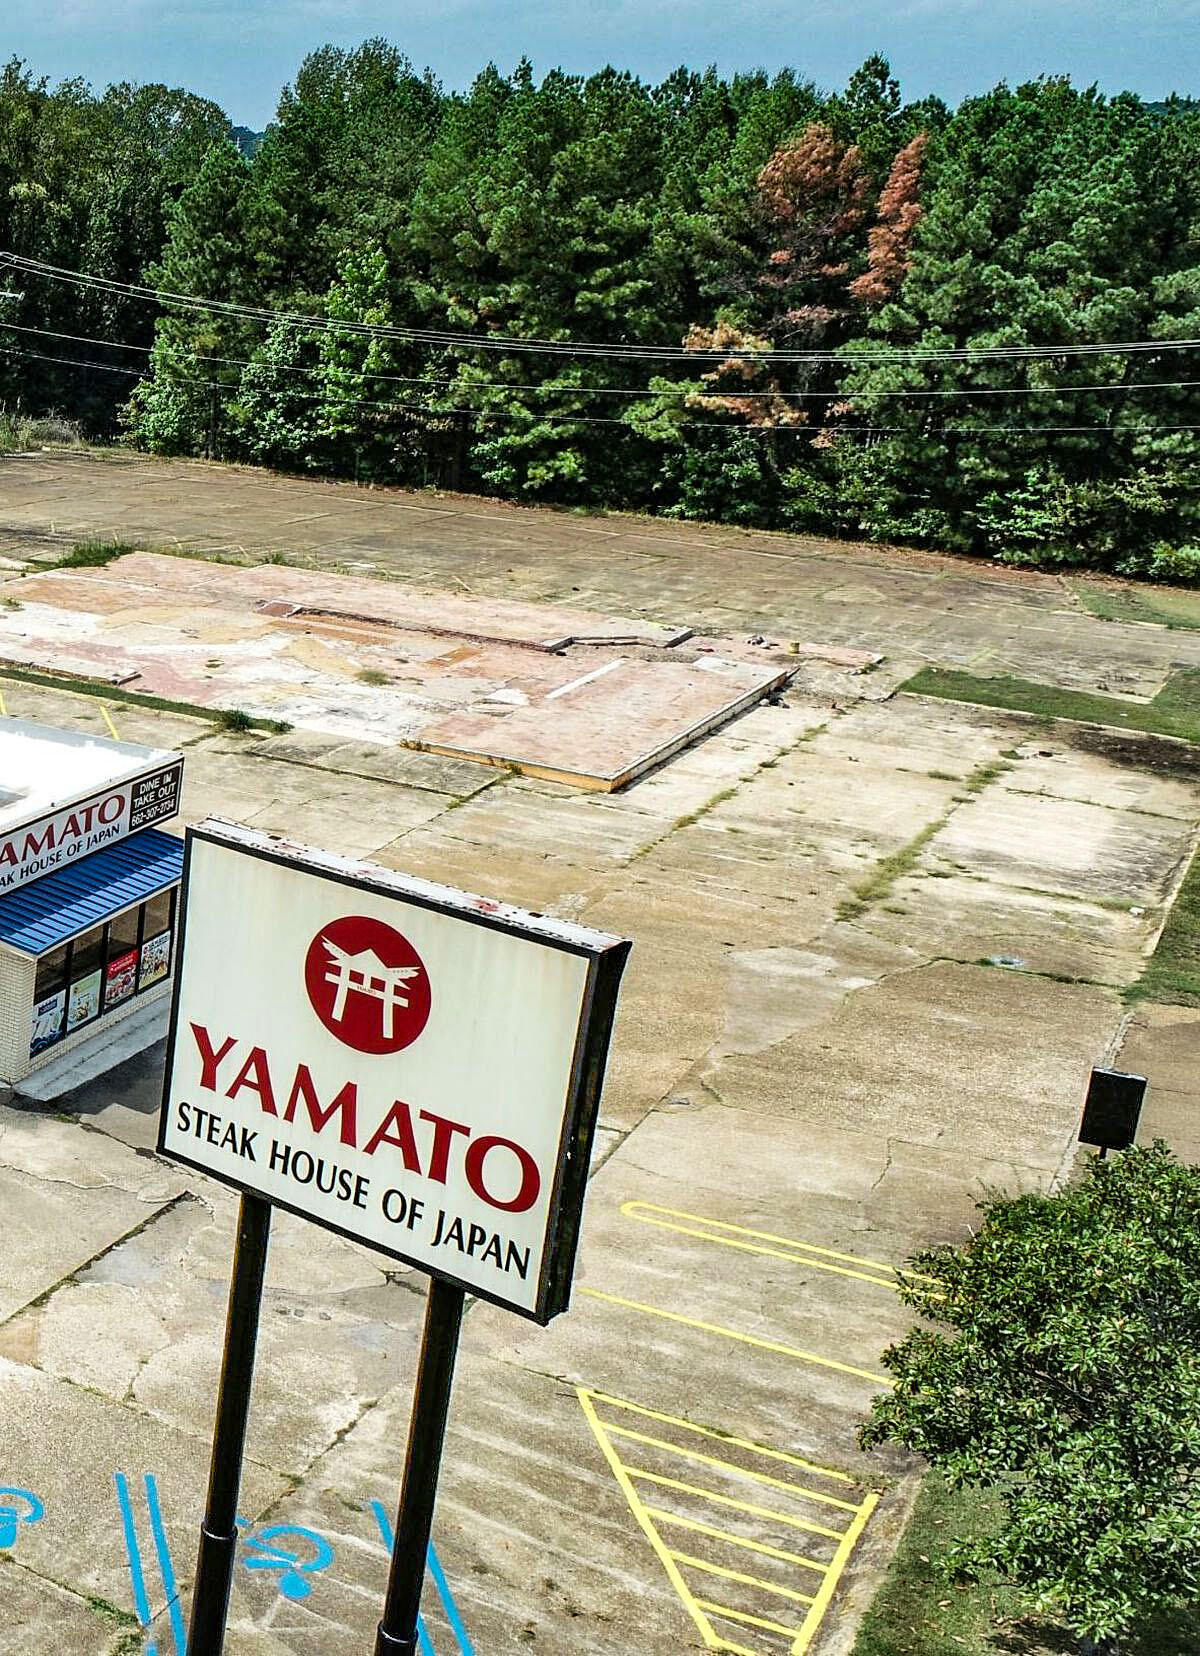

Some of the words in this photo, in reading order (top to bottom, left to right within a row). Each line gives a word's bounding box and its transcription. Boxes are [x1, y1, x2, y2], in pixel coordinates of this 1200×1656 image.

[133, 791, 155, 808] TAKE
[158, 782, 176, 798] OUT
[140, 777, 160, 795] DINE
[163, 772, 173, 785] IN
[20, 850, 62, 879] HOUSE
[66, 841, 84, 857] OF
[87, 823, 120, 850] JAPAN
[189, 1022, 541, 1214] YAMATO
[177, 1102, 259, 1162] STEAK
[269, 1139, 370, 1209] HOUSE
[382, 1188, 425, 1231] OF
[431, 1209, 531, 1281] JAPAN
